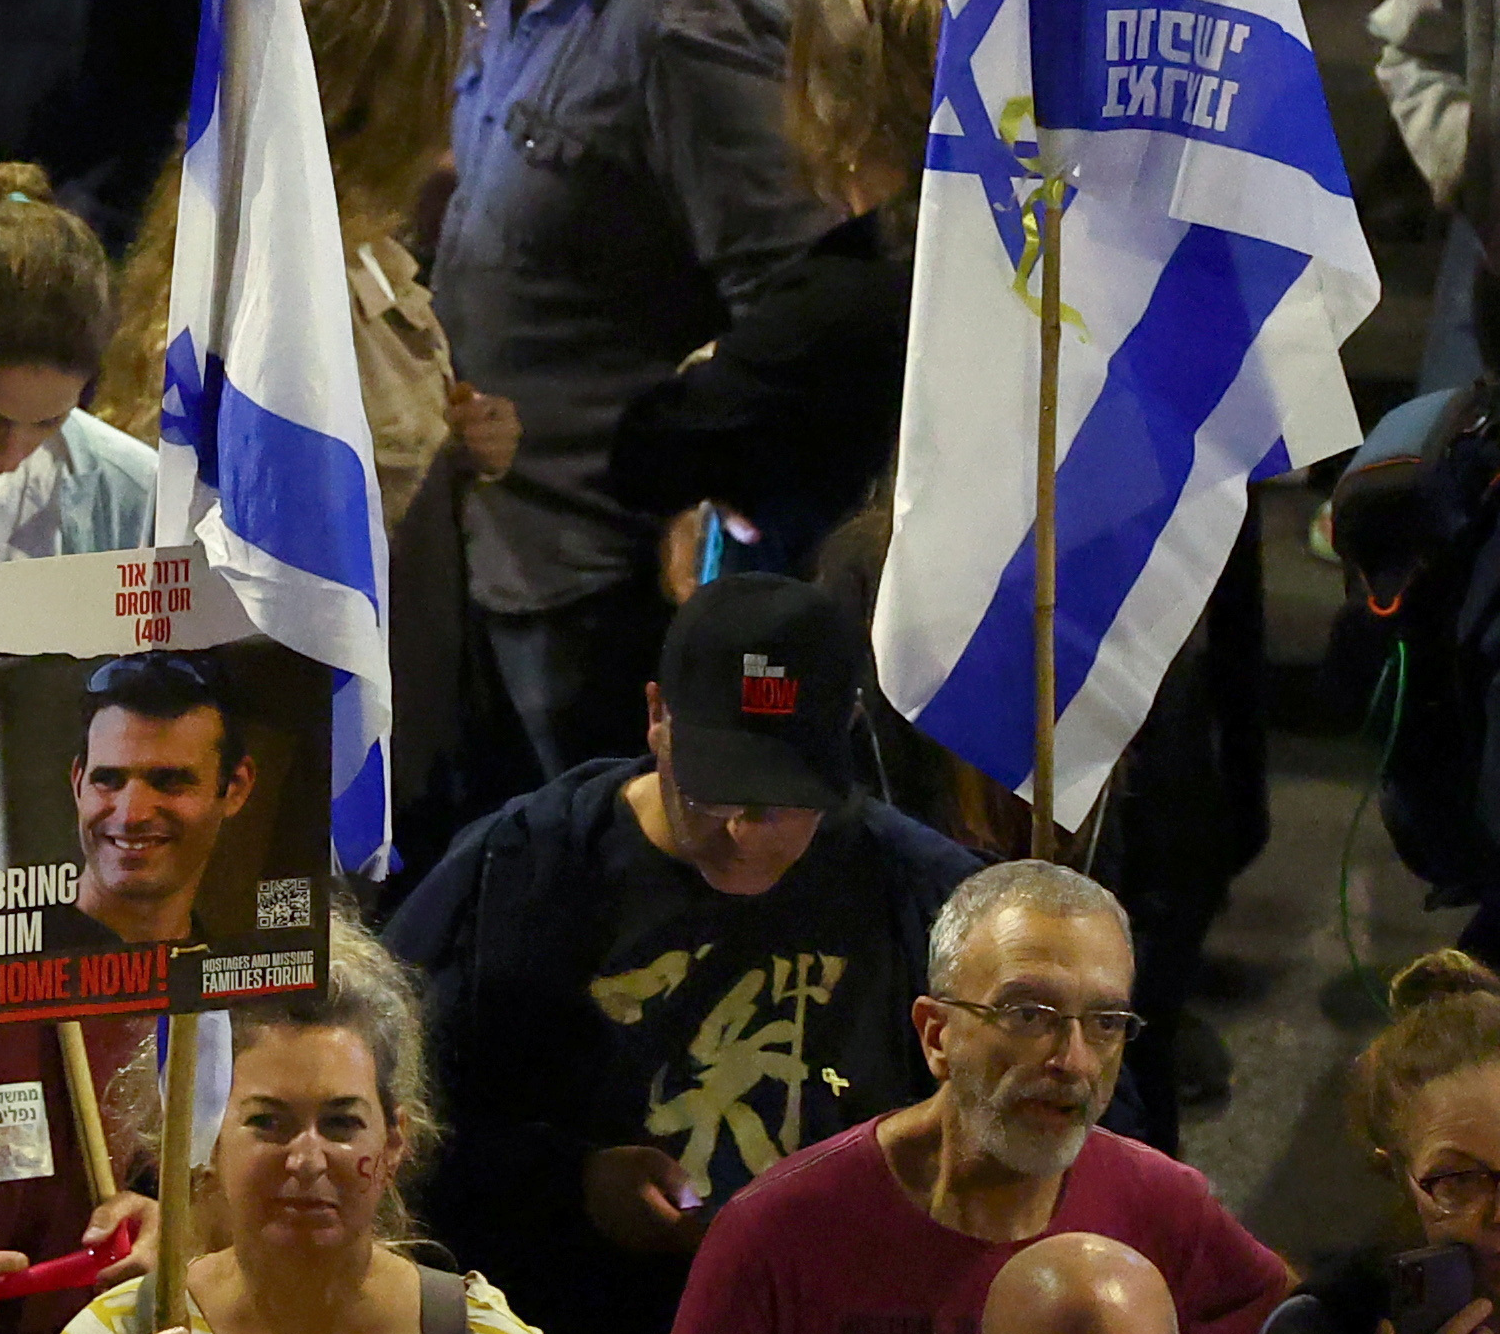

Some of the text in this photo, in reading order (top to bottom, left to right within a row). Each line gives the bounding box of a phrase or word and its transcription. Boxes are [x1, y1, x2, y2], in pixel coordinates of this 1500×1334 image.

[116, 559, 190, 587] דרור אור
[115, 588, 191, 616] DROR OR
[78, 944, 168, 999] NOW!
[202, 950, 314, 973] HOSTAGES AND MISSING
[202, 965, 314, 994] FAMILIES FORUM
